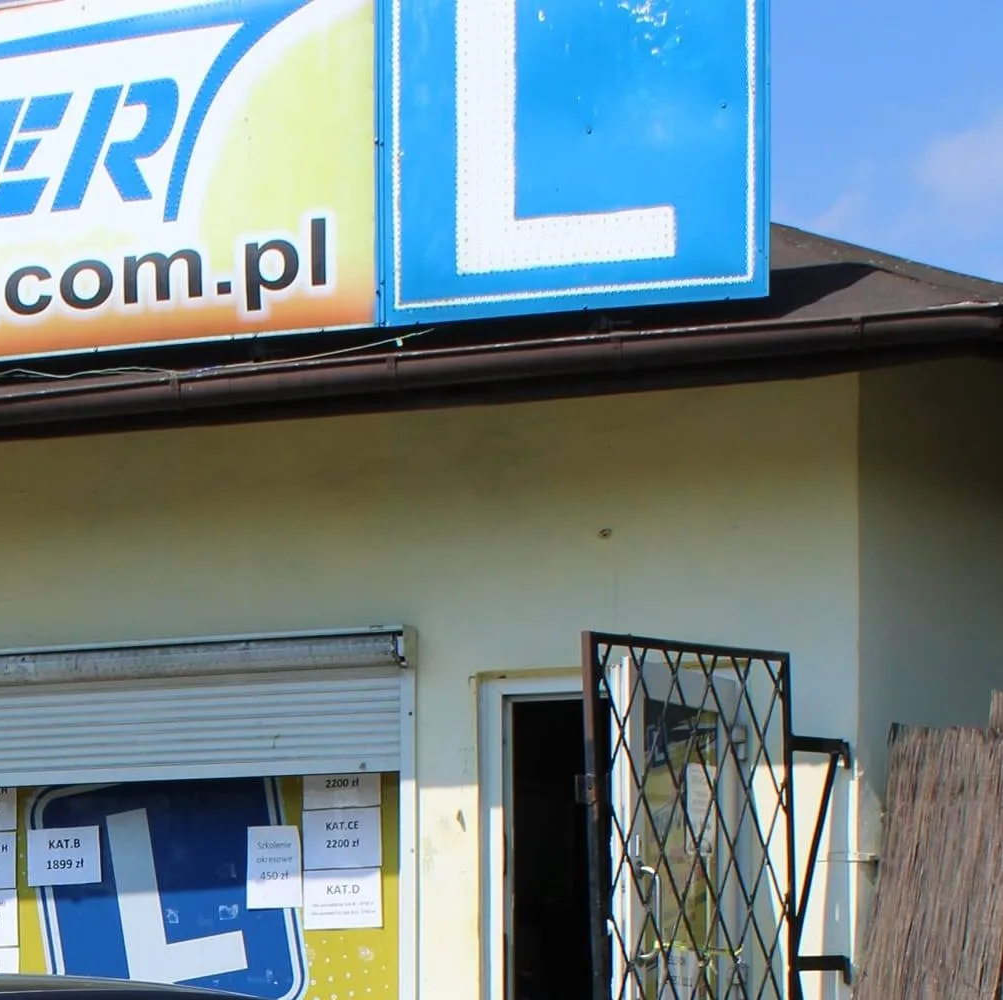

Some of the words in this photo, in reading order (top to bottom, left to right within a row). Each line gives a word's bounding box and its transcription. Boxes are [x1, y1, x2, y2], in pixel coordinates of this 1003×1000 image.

[455, 0, 676, 276] L
[325, 778, 349, 788] 2200
[351, 777, 360, 787] zł
[325, 820, 360, 831] KAT.CE
[1, 844, 8, 852] H
[48, 838, 81, 850] KAT.B
[256, 840, 292, 850] Szkolenie
[325, 839, 350, 849] 2200
[352, 838, 360, 848] zł
[46, 859, 73, 870] 1899
[75, 858, 84, 869] zł
[255, 855, 293, 864] okresowe
[259, 871, 279, 881] 450
[326, 884, 360, 896] KAT.D
